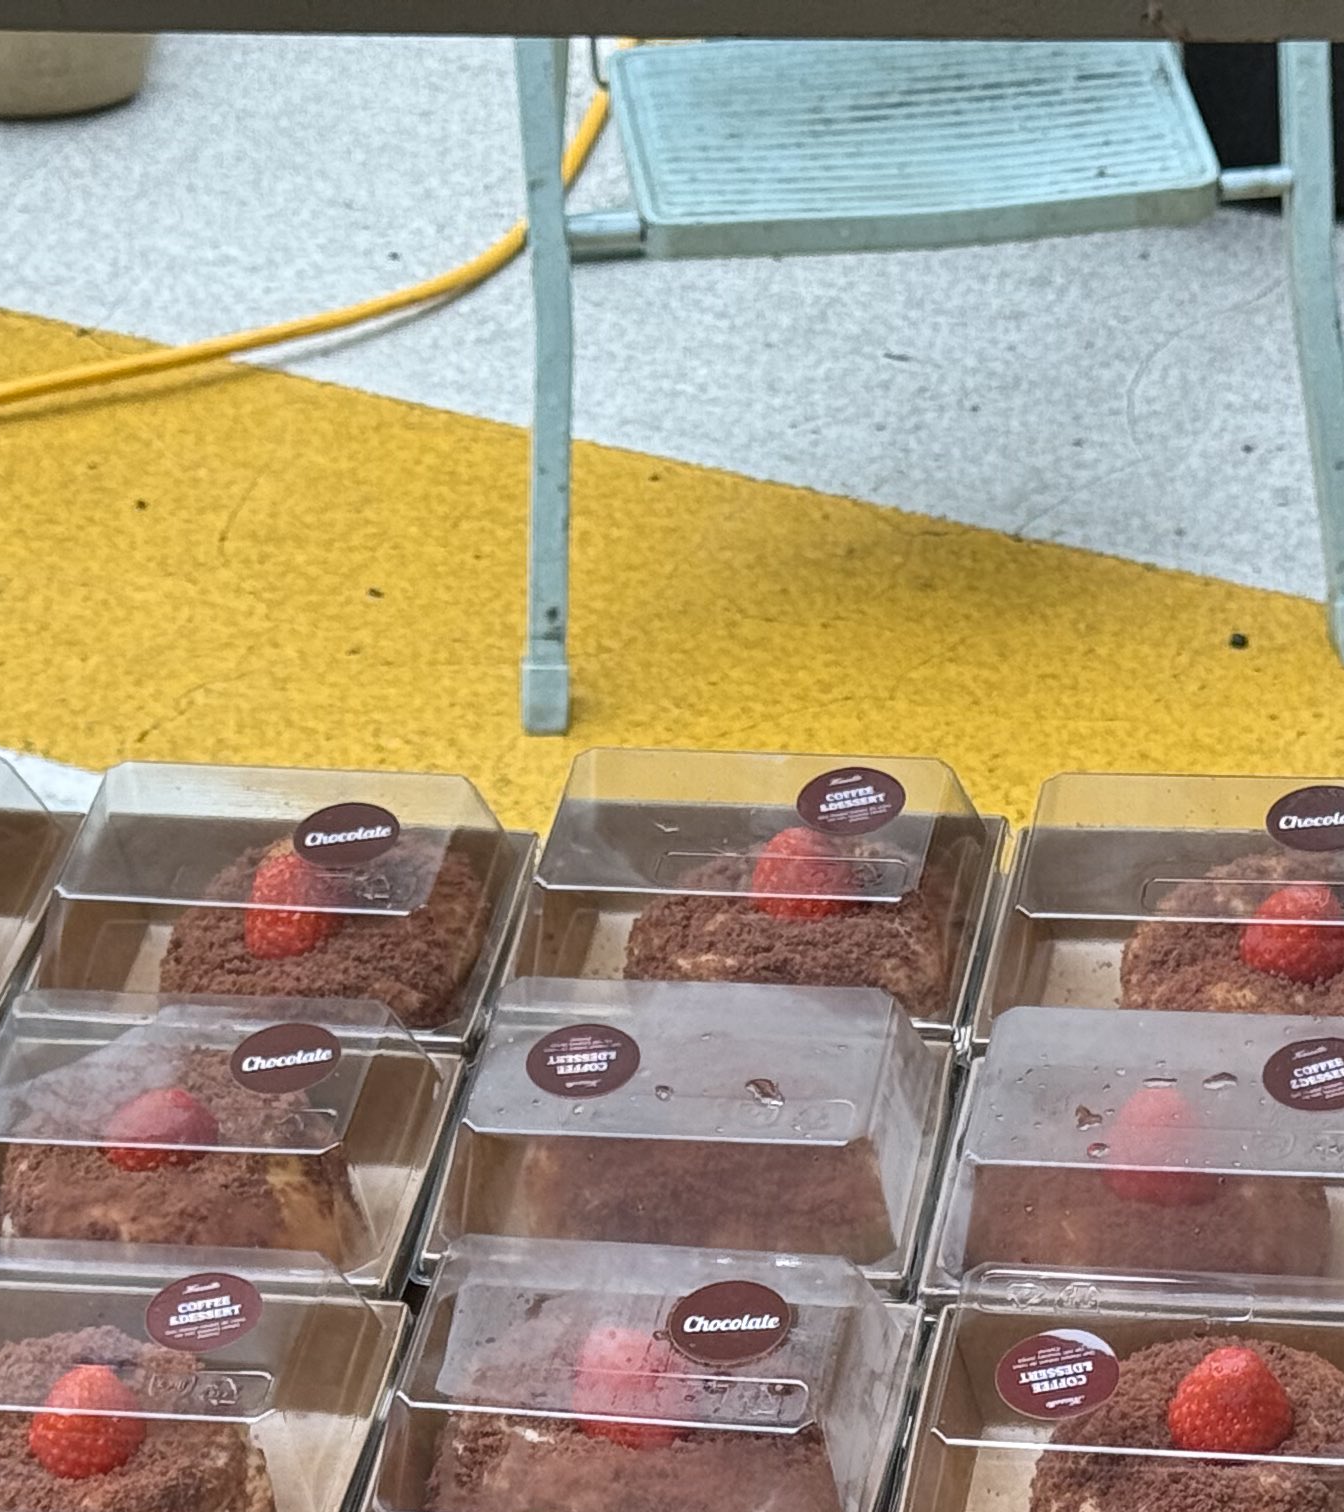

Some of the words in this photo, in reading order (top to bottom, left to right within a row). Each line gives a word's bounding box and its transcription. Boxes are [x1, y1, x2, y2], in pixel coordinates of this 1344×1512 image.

[304, 826, 392, 847] Chocolate
[242, 1049, 333, 1072] Chocolate
[1293, 1057, 1344, 1077] COFFEE
[178, 1295, 231, 1313] COFFEE
[169, 1304, 242, 1326] &DESSERT
[683, 1315, 780, 1333] Chocolate
[1019, 1361, 1093, 1383] &DESSERT
[1032, 1375, 1087, 1393] COFFEE
